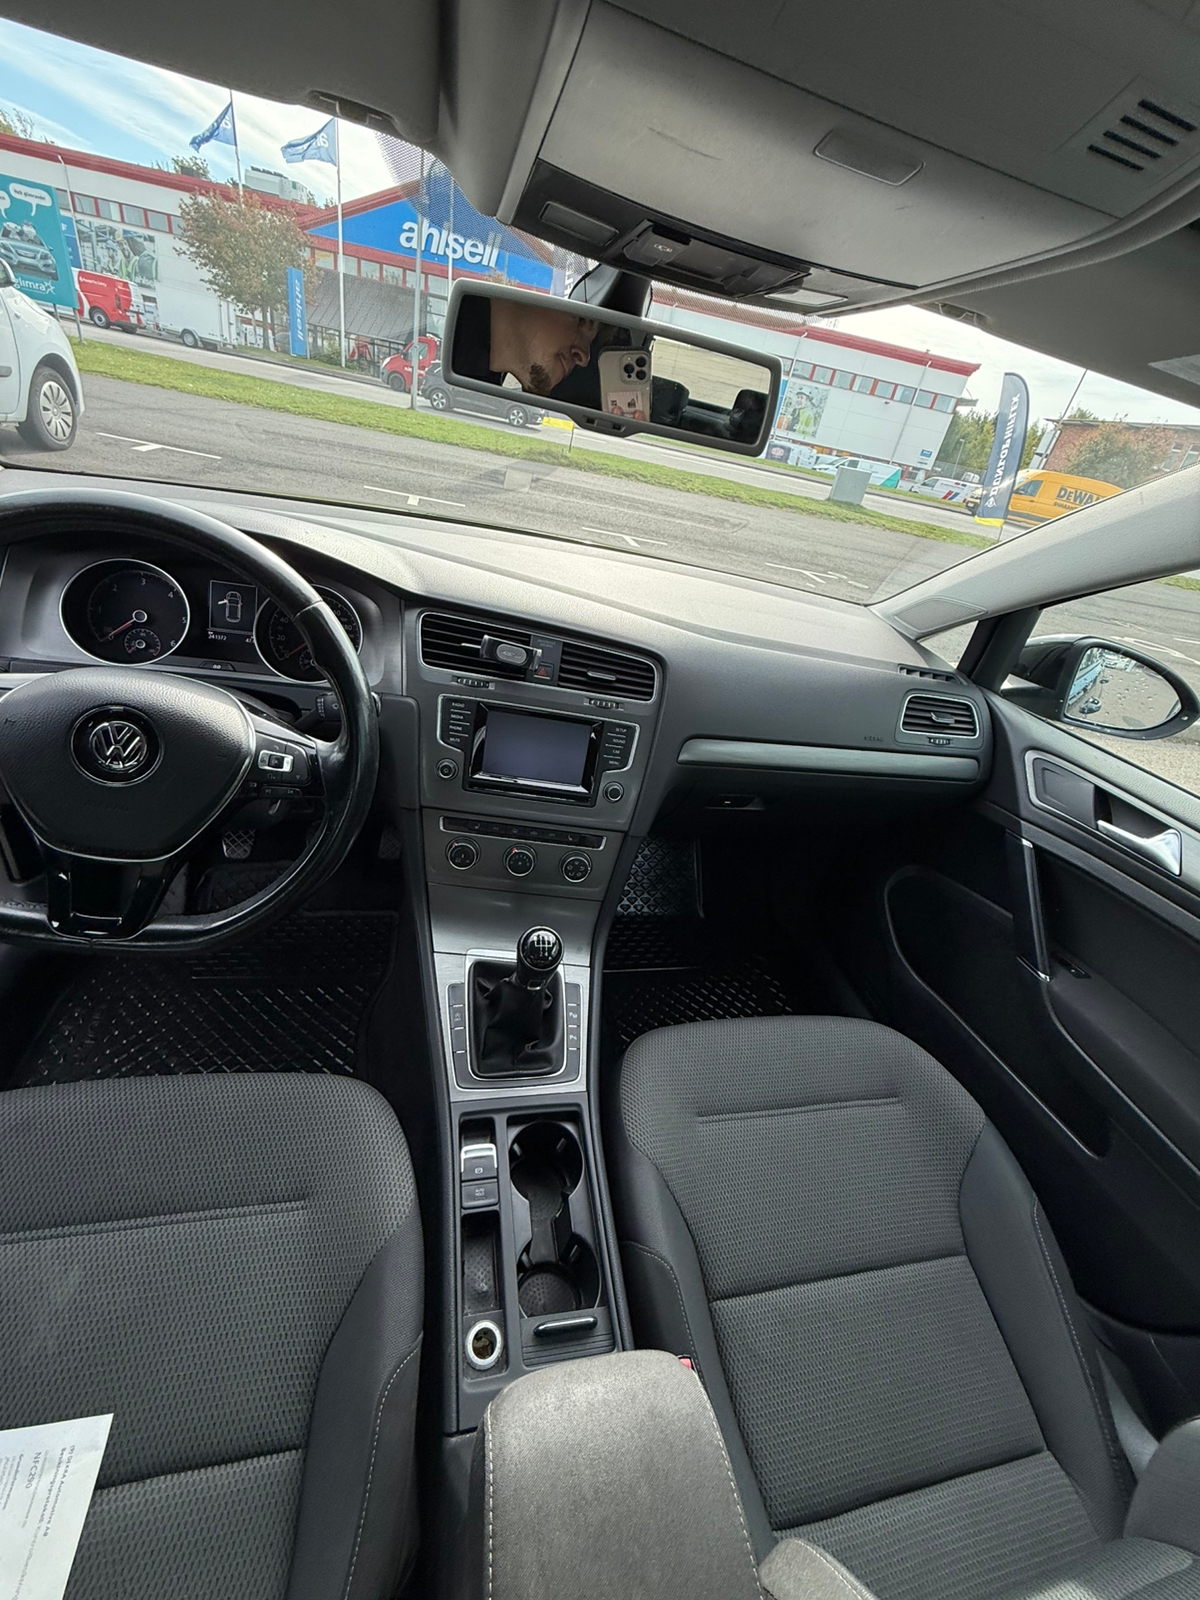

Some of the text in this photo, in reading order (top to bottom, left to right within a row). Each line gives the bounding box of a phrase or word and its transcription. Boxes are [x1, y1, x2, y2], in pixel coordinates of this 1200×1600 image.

[400, 216, 502, 268] ahlsell
[295, 279, 304, 341] ahlsell
[25, 1452, 42, 1489] NFC290
